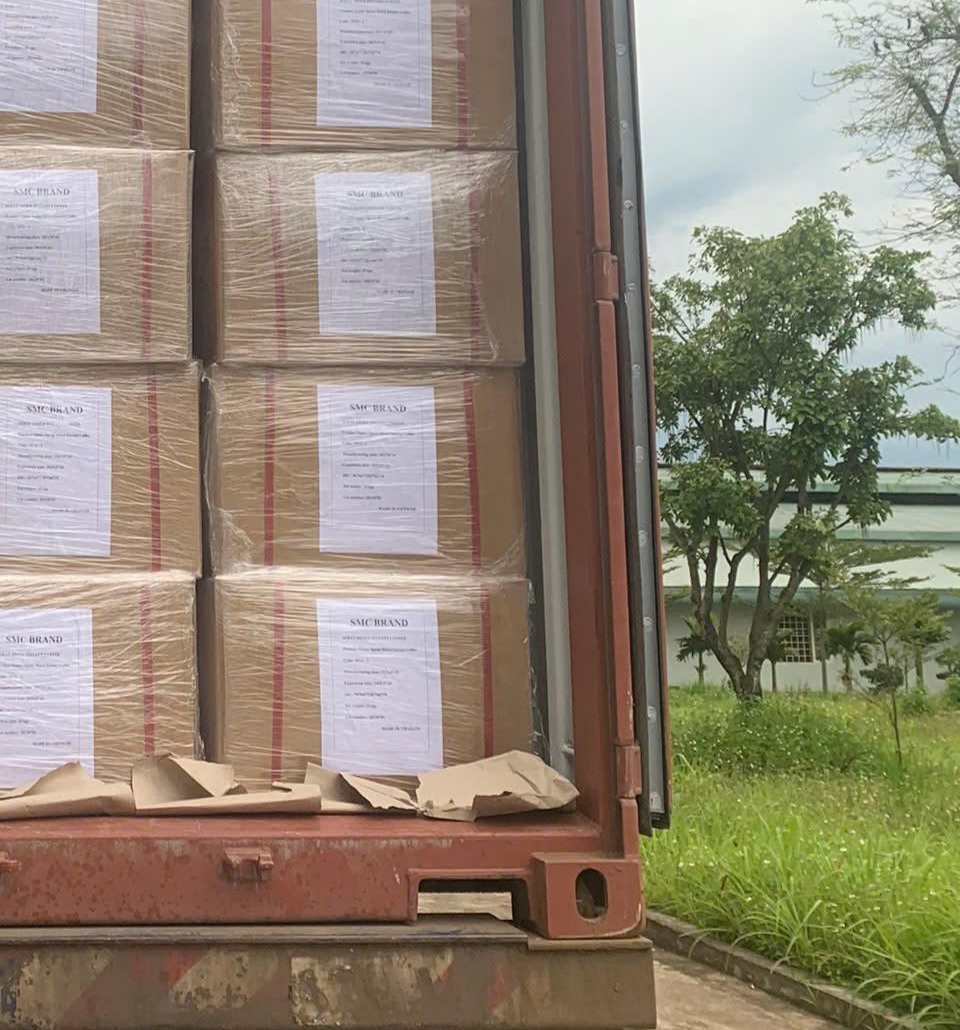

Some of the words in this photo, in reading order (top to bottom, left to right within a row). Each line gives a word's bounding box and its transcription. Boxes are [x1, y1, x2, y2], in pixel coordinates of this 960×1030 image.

[13, 187, 35, 196] SMC
[36, 187, 71, 196] BRAND
[25, 404, 48, 414] SMC
[49, 405, 84, 415] BRAND
[349, 403, 371, 412] SMC
[372, 403, 407, 413] BRAND
[350, 618, 372, 627] SMC
[374, 618, 409, 628] BRAND
[5, 635, 26, 644] SMC
[29, 635, 63, 644] BRAND
